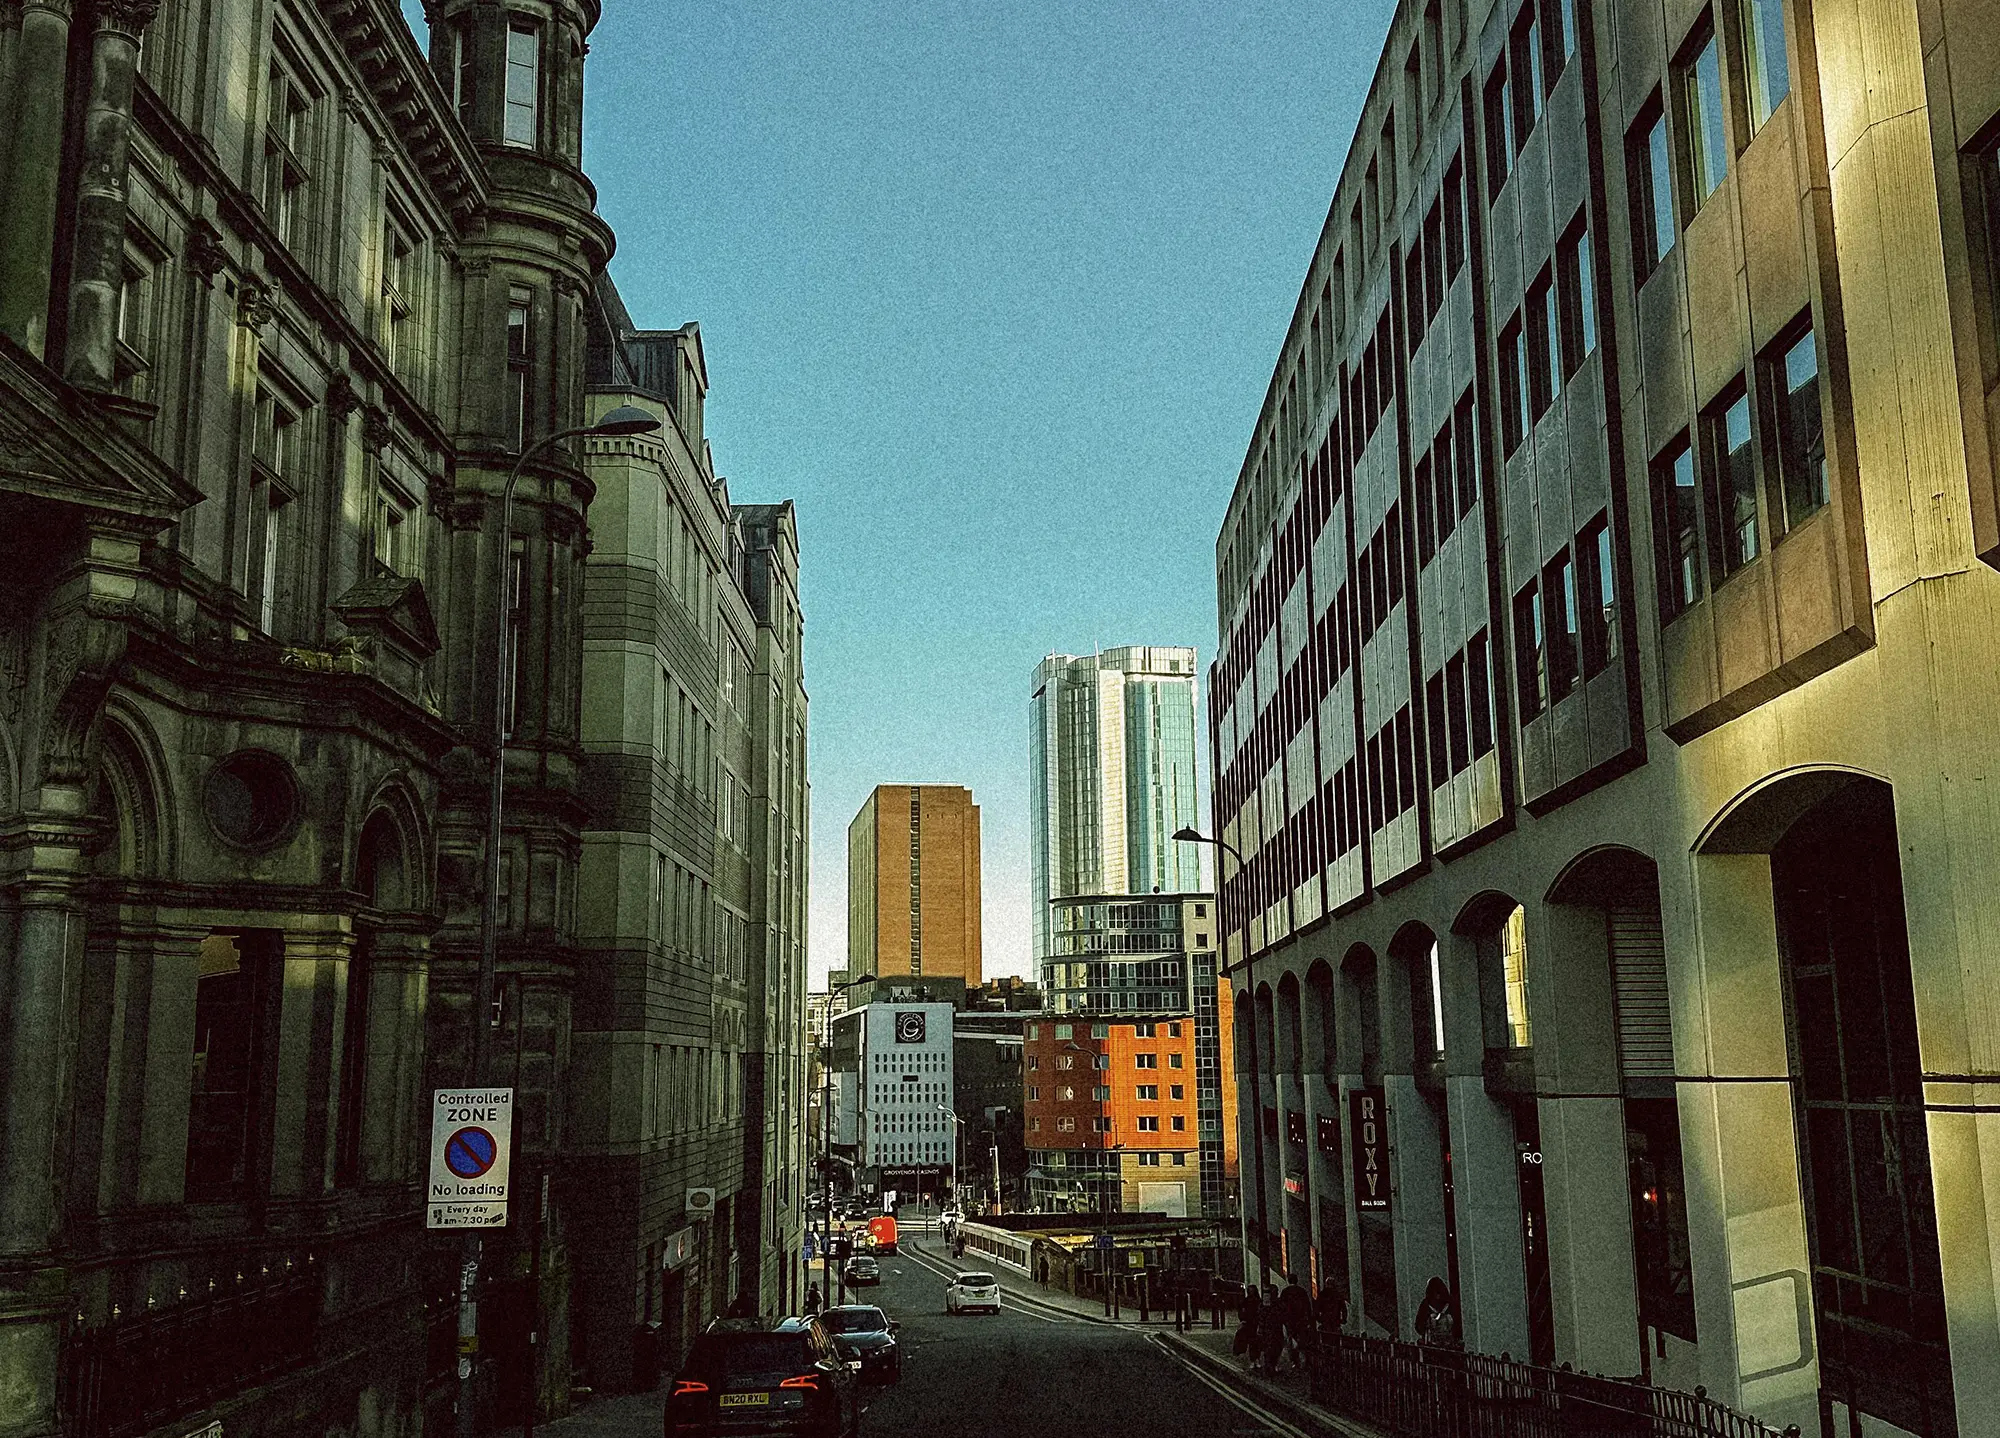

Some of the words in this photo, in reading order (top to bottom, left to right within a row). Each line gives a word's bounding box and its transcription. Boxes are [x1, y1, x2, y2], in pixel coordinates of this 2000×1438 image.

[438, 1093, 509, 1104] Controlled
[447, 1108, 497, 1122] ZONE
[1361, 1096, 1378, 1196] ROXY
[432, 1185, 452, 1196] No
[456, 1183, 505, 1196] loading
[446, 1205, 471, 1215] Every
[472, 1205, 489, 1214] day
[462, 1216, 483, 1225] 7.30
[747, 1393, 765, 1404] RXL
